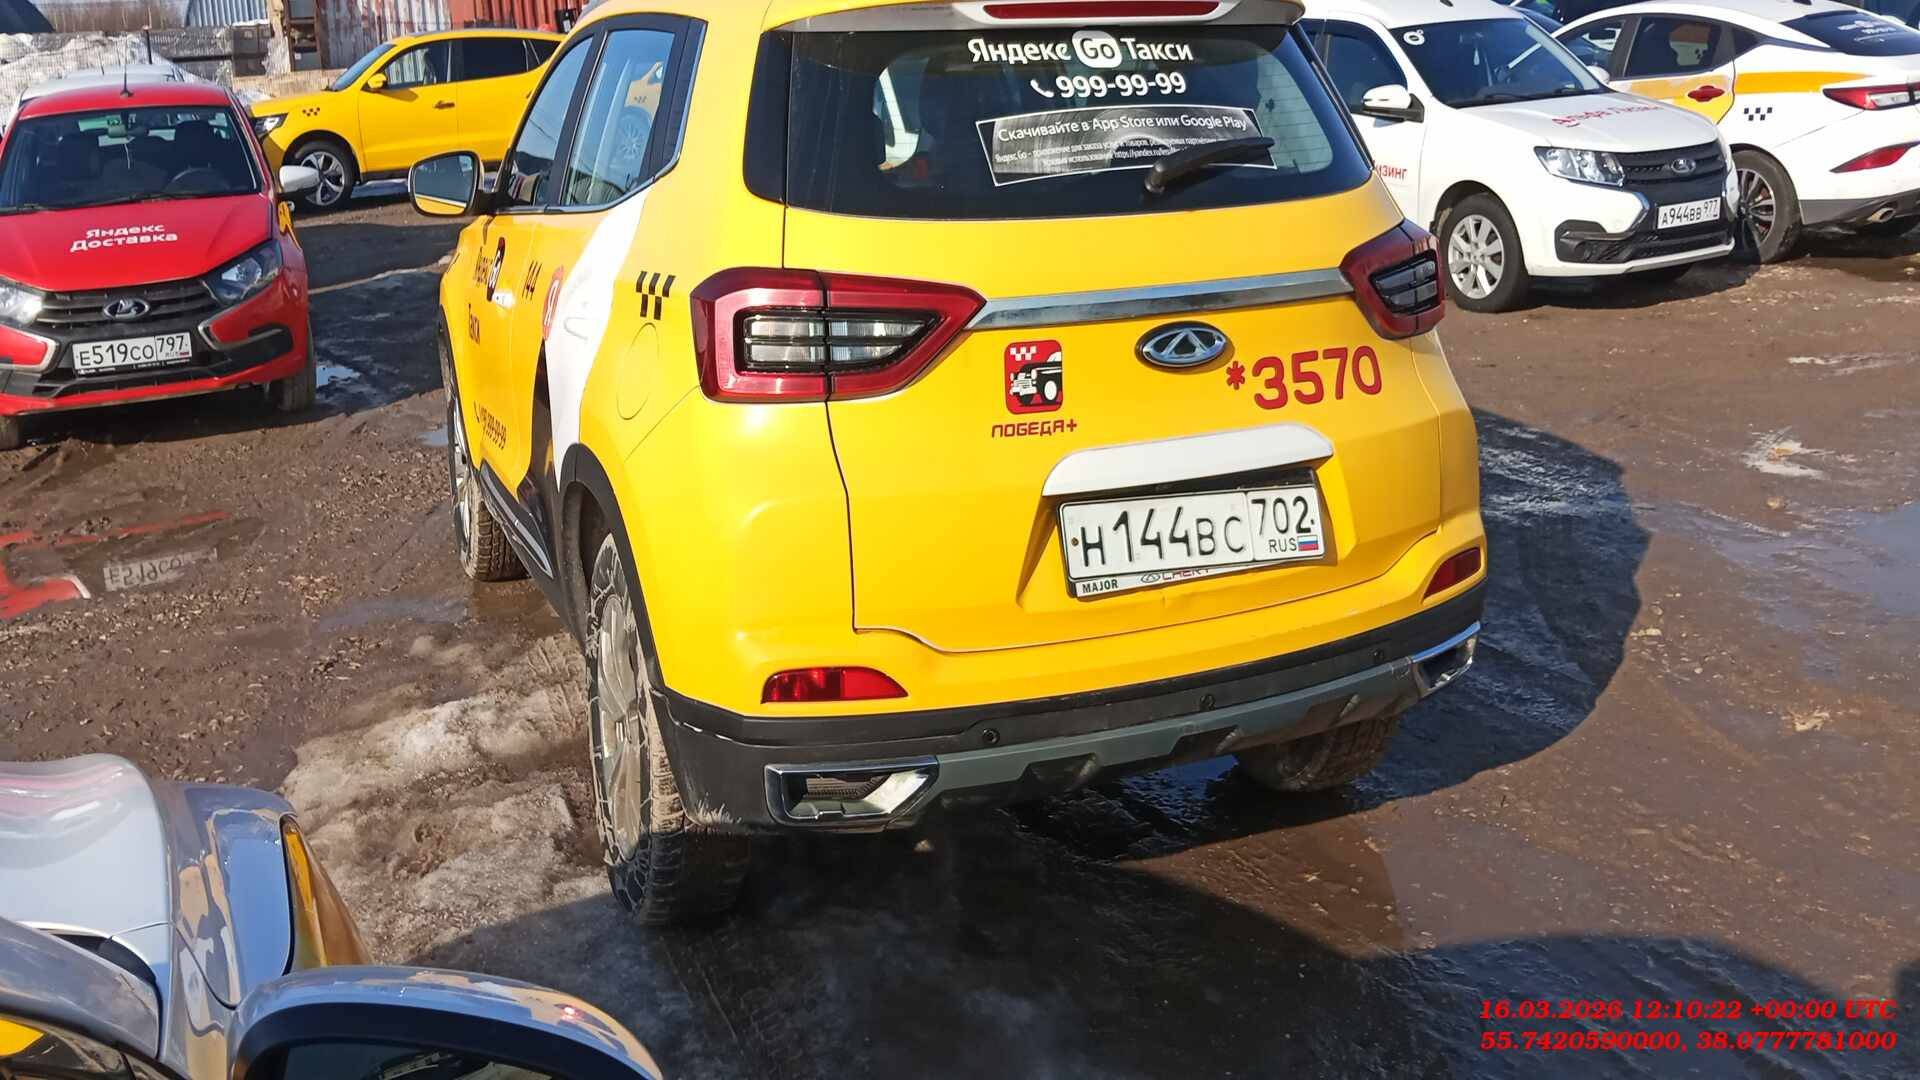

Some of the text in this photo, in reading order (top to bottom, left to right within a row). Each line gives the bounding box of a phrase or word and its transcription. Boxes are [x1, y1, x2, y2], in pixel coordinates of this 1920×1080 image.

[967, 36, 1195, 65] Яндекс Go Такси
[1055, 71, 1187, 98] 999-99-99
[998, 114, 1248, 142] Скачивайте в App Store или Google Play
[1374, 163, 1407, 181] изинг
[70, 233, 178, 253] Доставка
[86, 224, 166, 239] Яндекс
[79, 342, 156, 367] Е519СО
[157, 335, 184, 353] 797
[1080, 495, 1311, 567] Н144ВС 702
[1268, 537, 1298, 553] RUS
[1082, 579, 1119, 594] MAJOR
